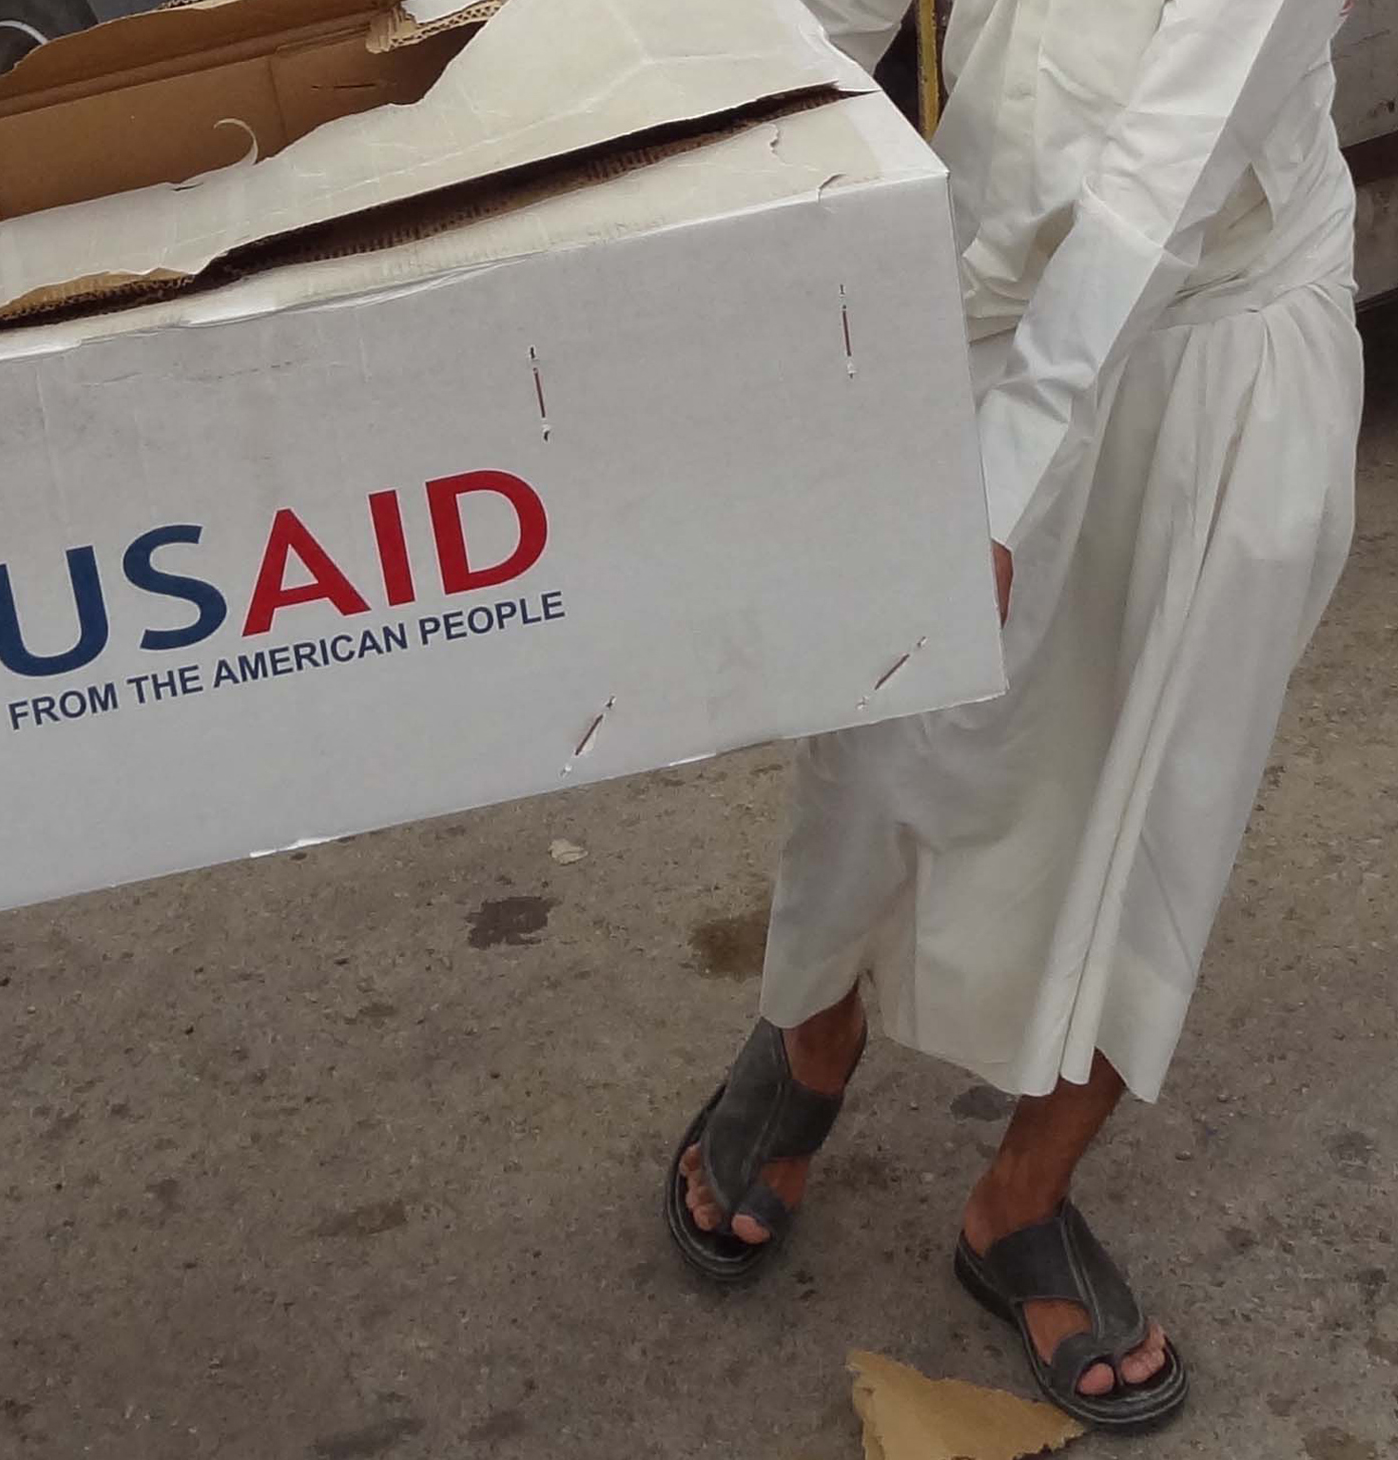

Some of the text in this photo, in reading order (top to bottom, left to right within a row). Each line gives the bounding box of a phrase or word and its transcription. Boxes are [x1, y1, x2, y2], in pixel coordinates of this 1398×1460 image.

[8, 590, 566, 731] FROM THE AMERICAN PEOPLE
